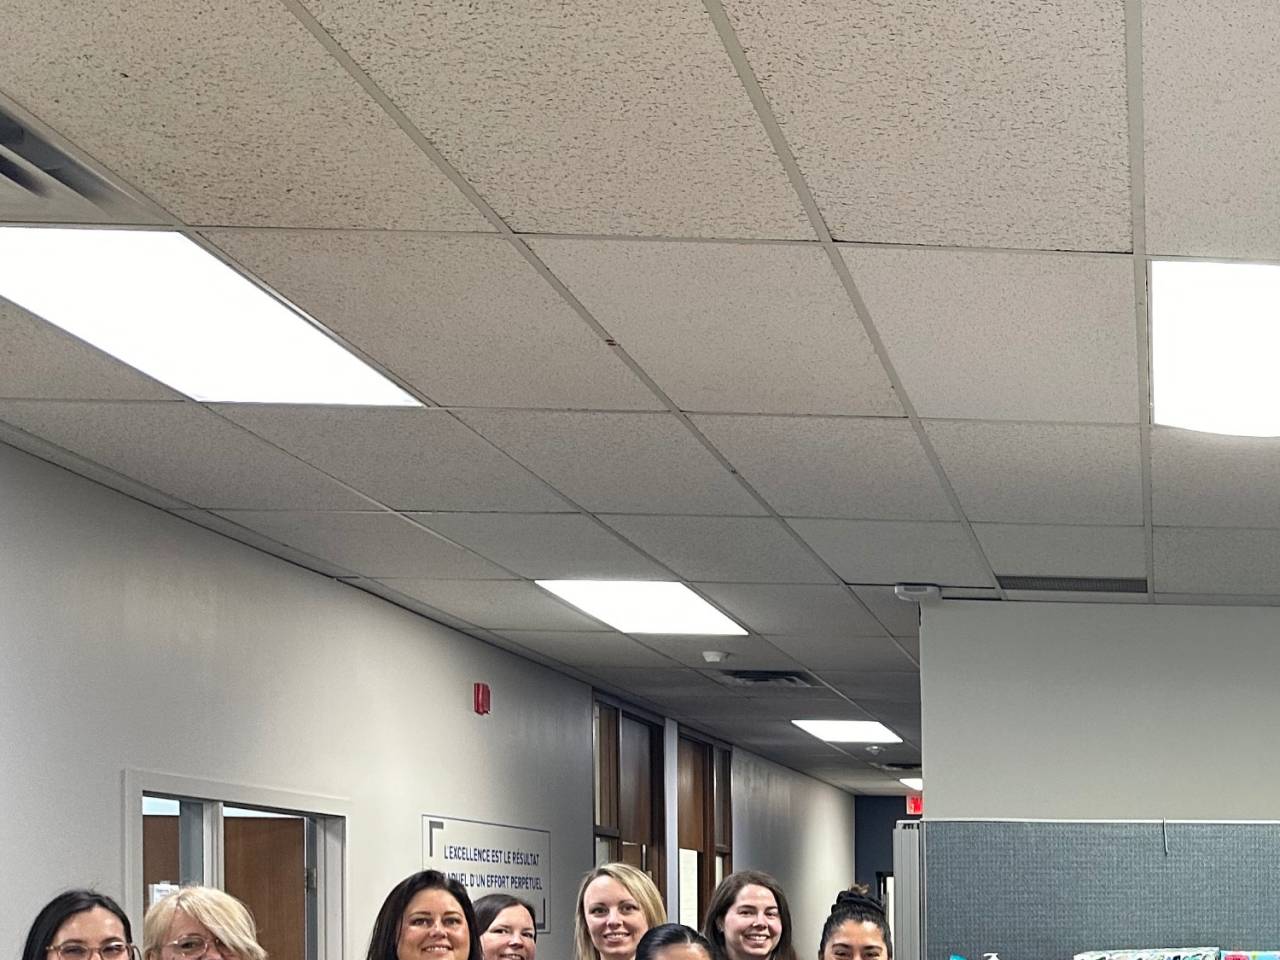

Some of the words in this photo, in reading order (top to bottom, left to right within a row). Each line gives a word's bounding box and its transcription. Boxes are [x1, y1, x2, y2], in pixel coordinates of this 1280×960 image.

[444, 846, 490, 863] L'EXCELLENCE
[492, 850, 502, 863] EST
[504, 851, 511, 864] LE
[512, 849, 539, 866] RÉSULTAT
[470, 874, 485, 888] D'UN
[486, 874, 509, 888] EFFORT
[510, 874, 543, 890] PERPÉTUEL
